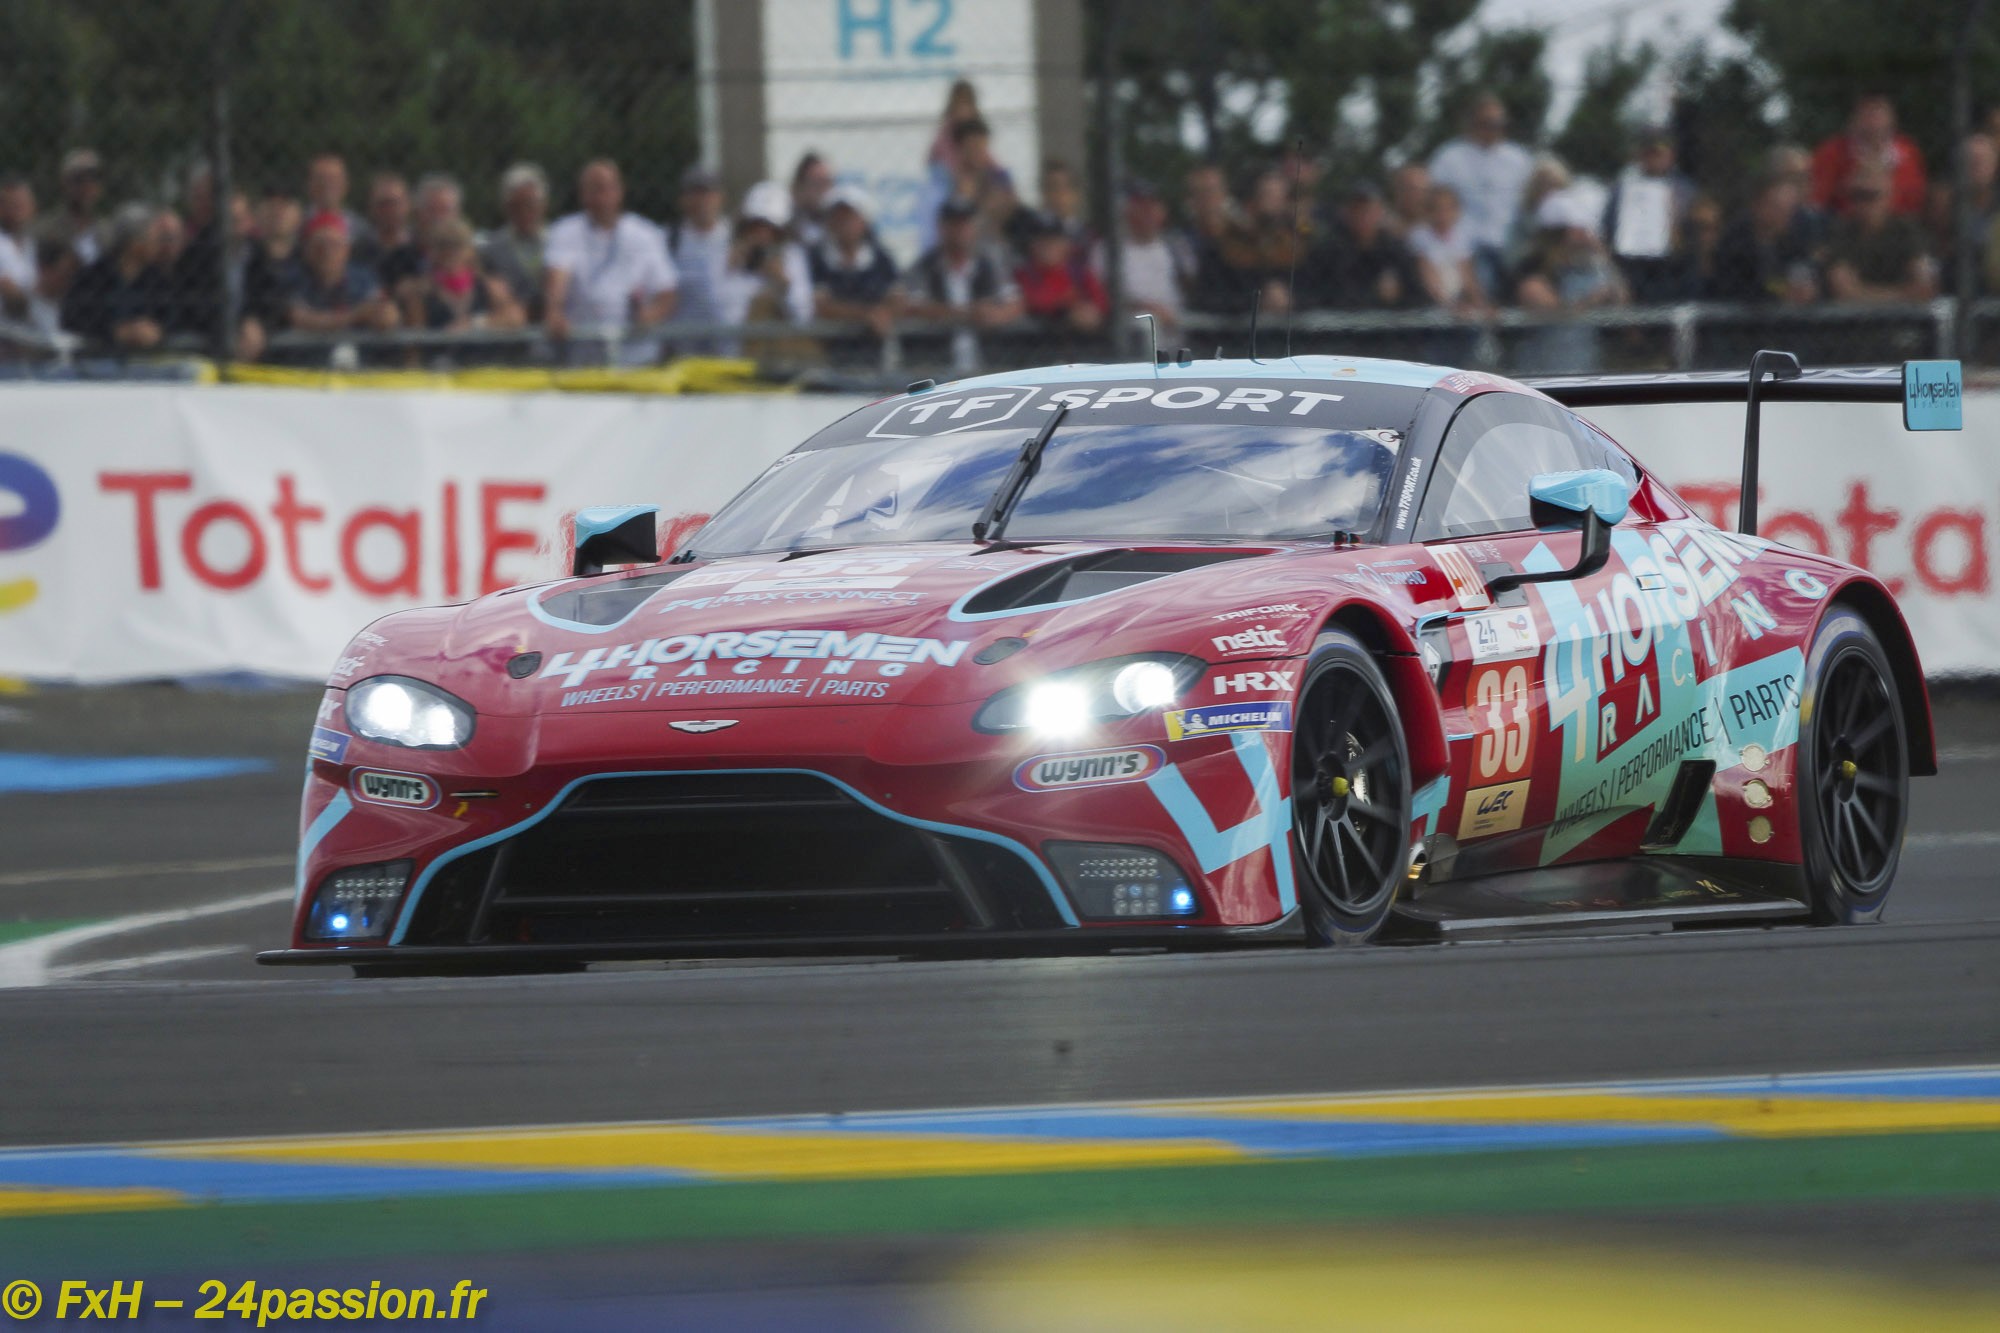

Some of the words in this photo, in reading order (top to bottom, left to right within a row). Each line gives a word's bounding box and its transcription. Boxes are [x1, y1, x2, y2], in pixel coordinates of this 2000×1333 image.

[836, 0, 956, 58] H2
[908, 393, 1016, 425] TF
[1036, 386, 1345, 416] SPORT
[1210, 624, 1288, 652] netic
[540, 629, 970, 688] 4HORSEMEN
[629, 658, 910, 680] RACING
[1601, 569, 1828, 754] RACING
[561, 683, 642, 707] WHEELS
[656, 677, 805, 697] PERFORMANCE
[820, 681, 890, 699] PARTS
[1213, 670, 1296, 696] HRX
[1207, 710, 1283, 727] MICHELIN
[1476, 664, 1531, 778] 33
[1616, 706, 1715, 801] PERFORMANCE
[1728, 673, 1801, 731] PARTS
[1476, 789, 1514, 816] WEC
